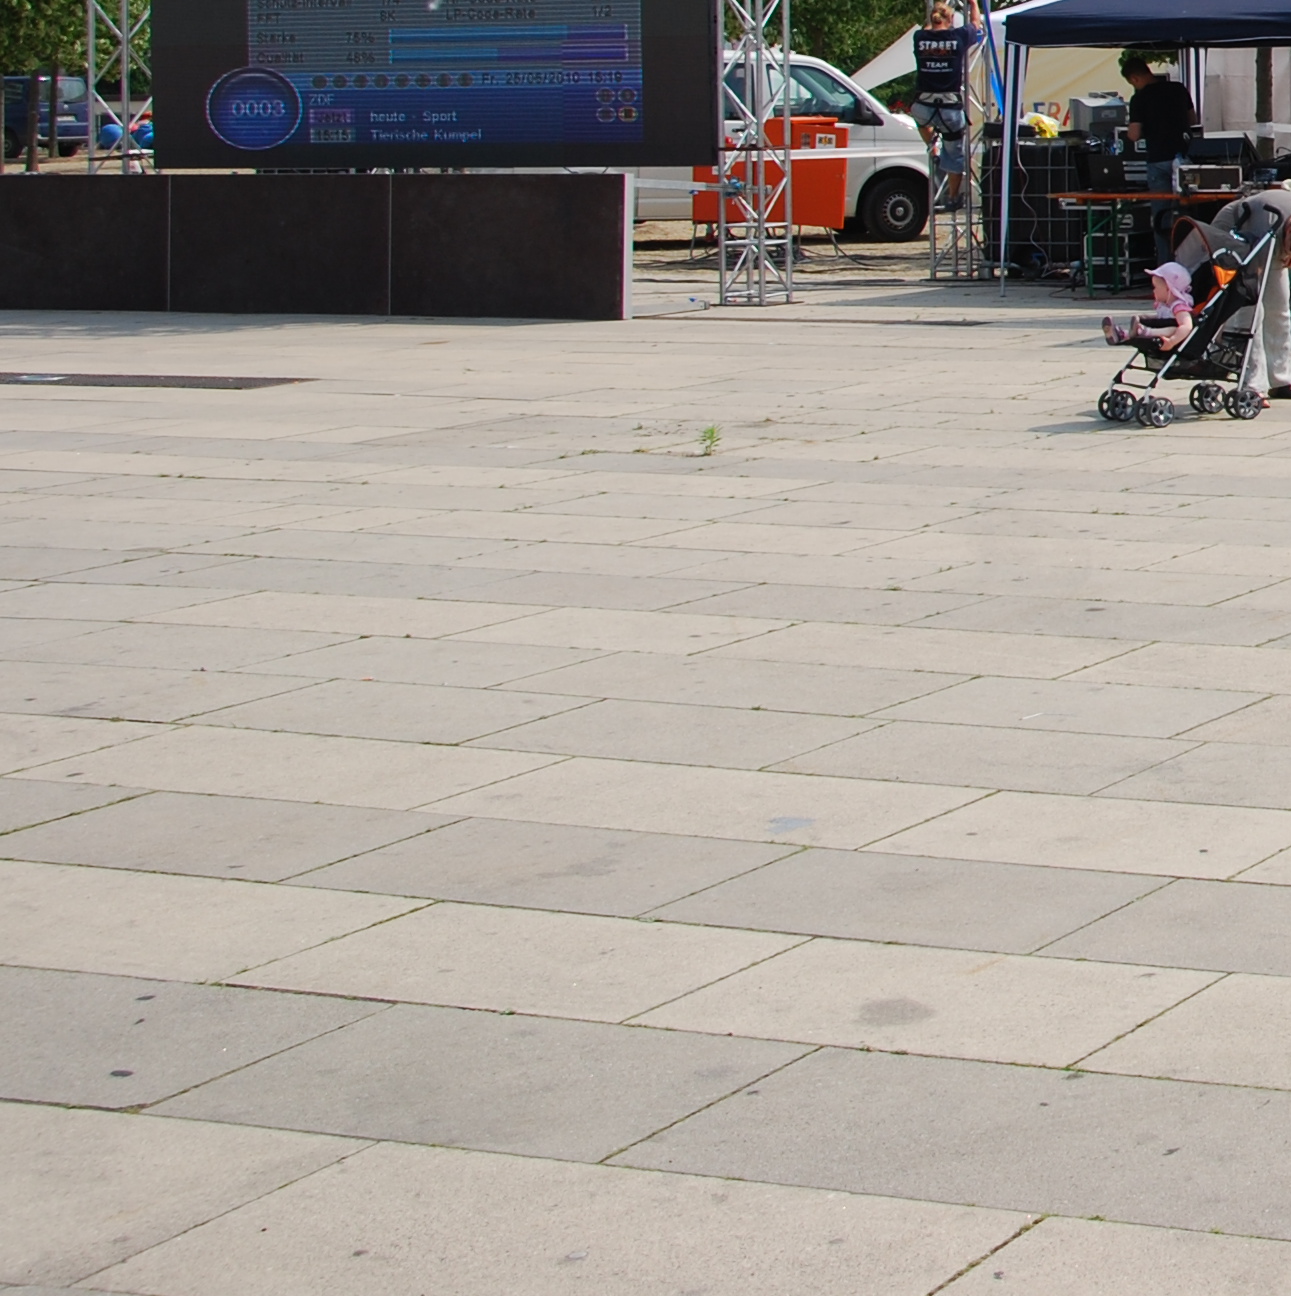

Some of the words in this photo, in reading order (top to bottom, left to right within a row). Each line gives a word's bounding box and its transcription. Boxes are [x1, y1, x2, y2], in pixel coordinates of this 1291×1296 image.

[445, 8, 536, 20] LP-Code-Rate
[592, 5, 613, 17] 1/2
[256, 12, 281, 24] FFT
[918, 40, 958, 51] STREET
[308, 93, 335, 106] ZDF
[231, 100, 286, 117] 0003
[370, 111, 406, 122] heute
[422, 110, 458, 124] Sport
[370, 129, 428, 141] Tierische
[433, 128, 482, 142] Kumpel
